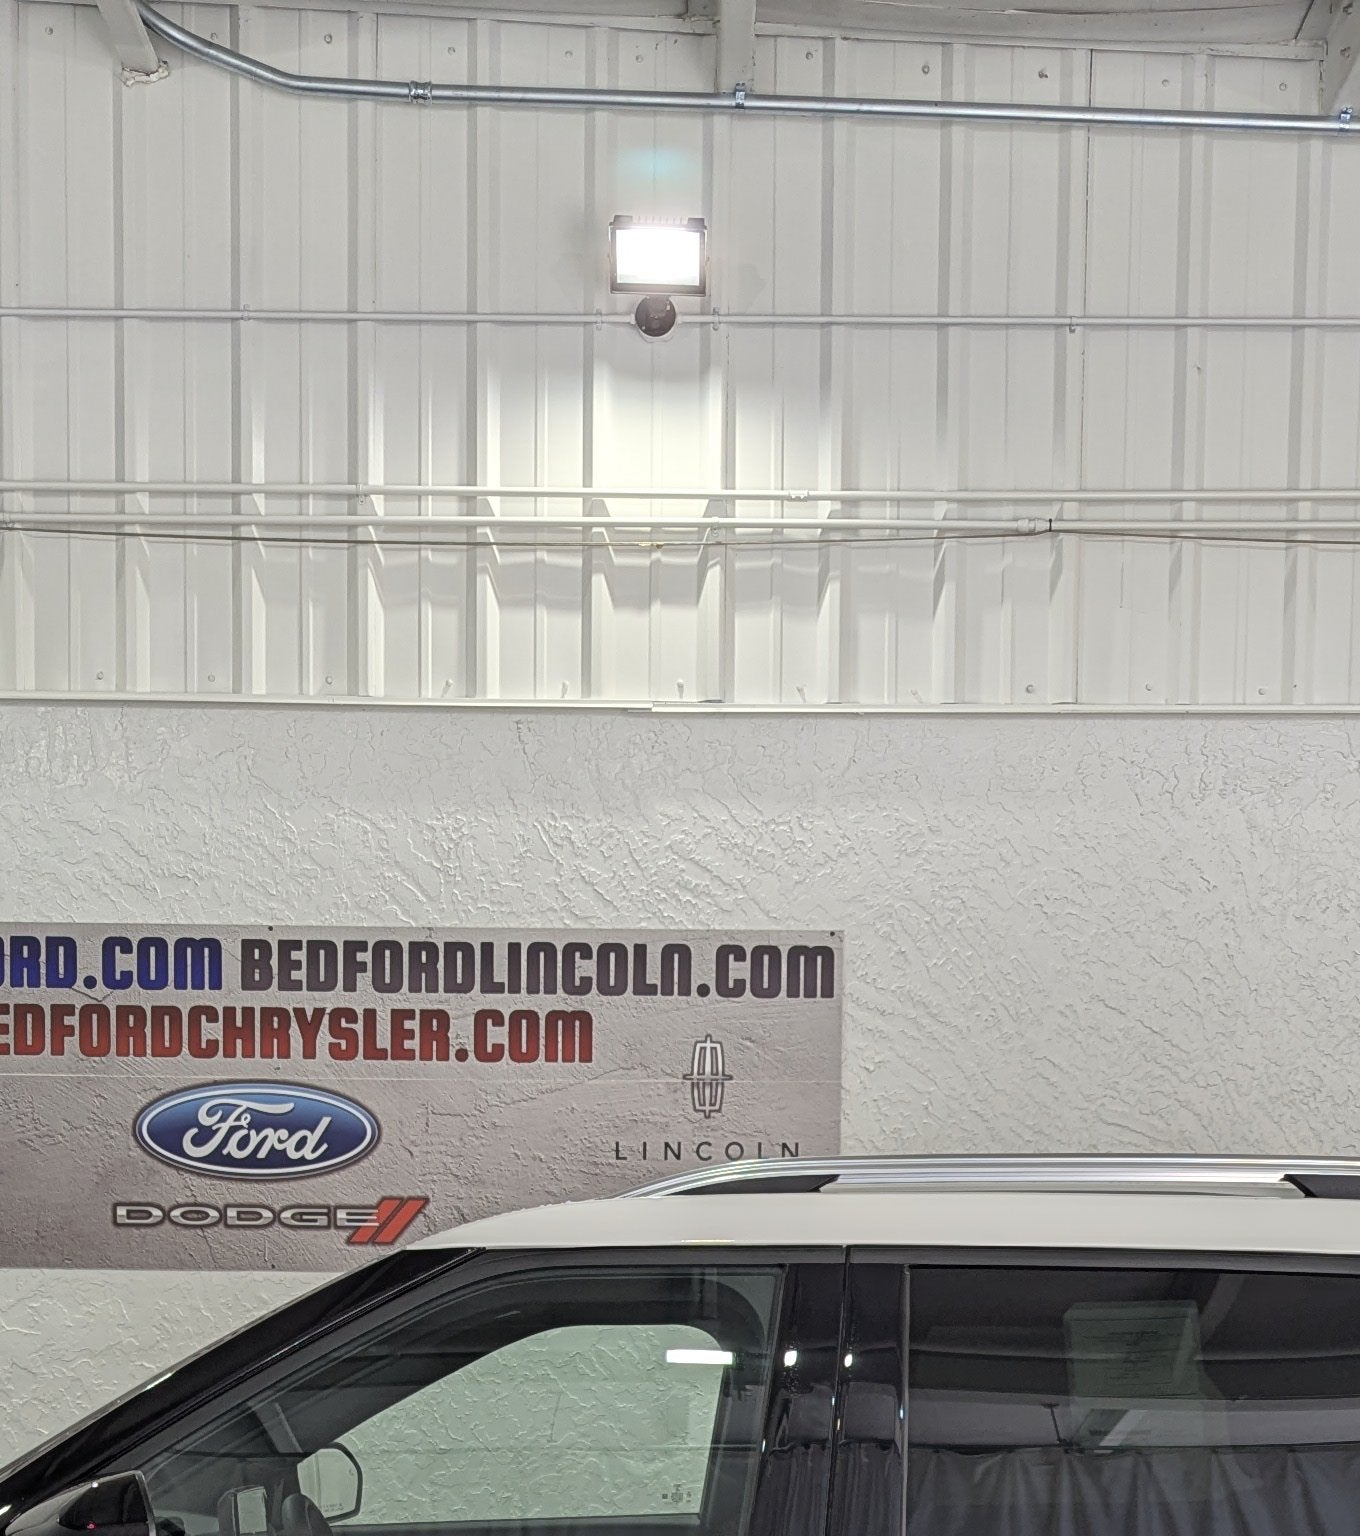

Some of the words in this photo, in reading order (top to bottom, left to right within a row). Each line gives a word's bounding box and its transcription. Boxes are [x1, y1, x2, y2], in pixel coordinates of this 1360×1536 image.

[240, 938, 836, 999] BEDFORDLINCOLN.COM
[181, 1098, 333, 1160] Ford
[614, 1141, 800, 1162] LINCOLN
[114, 1203, 380, 1229] DODGE
